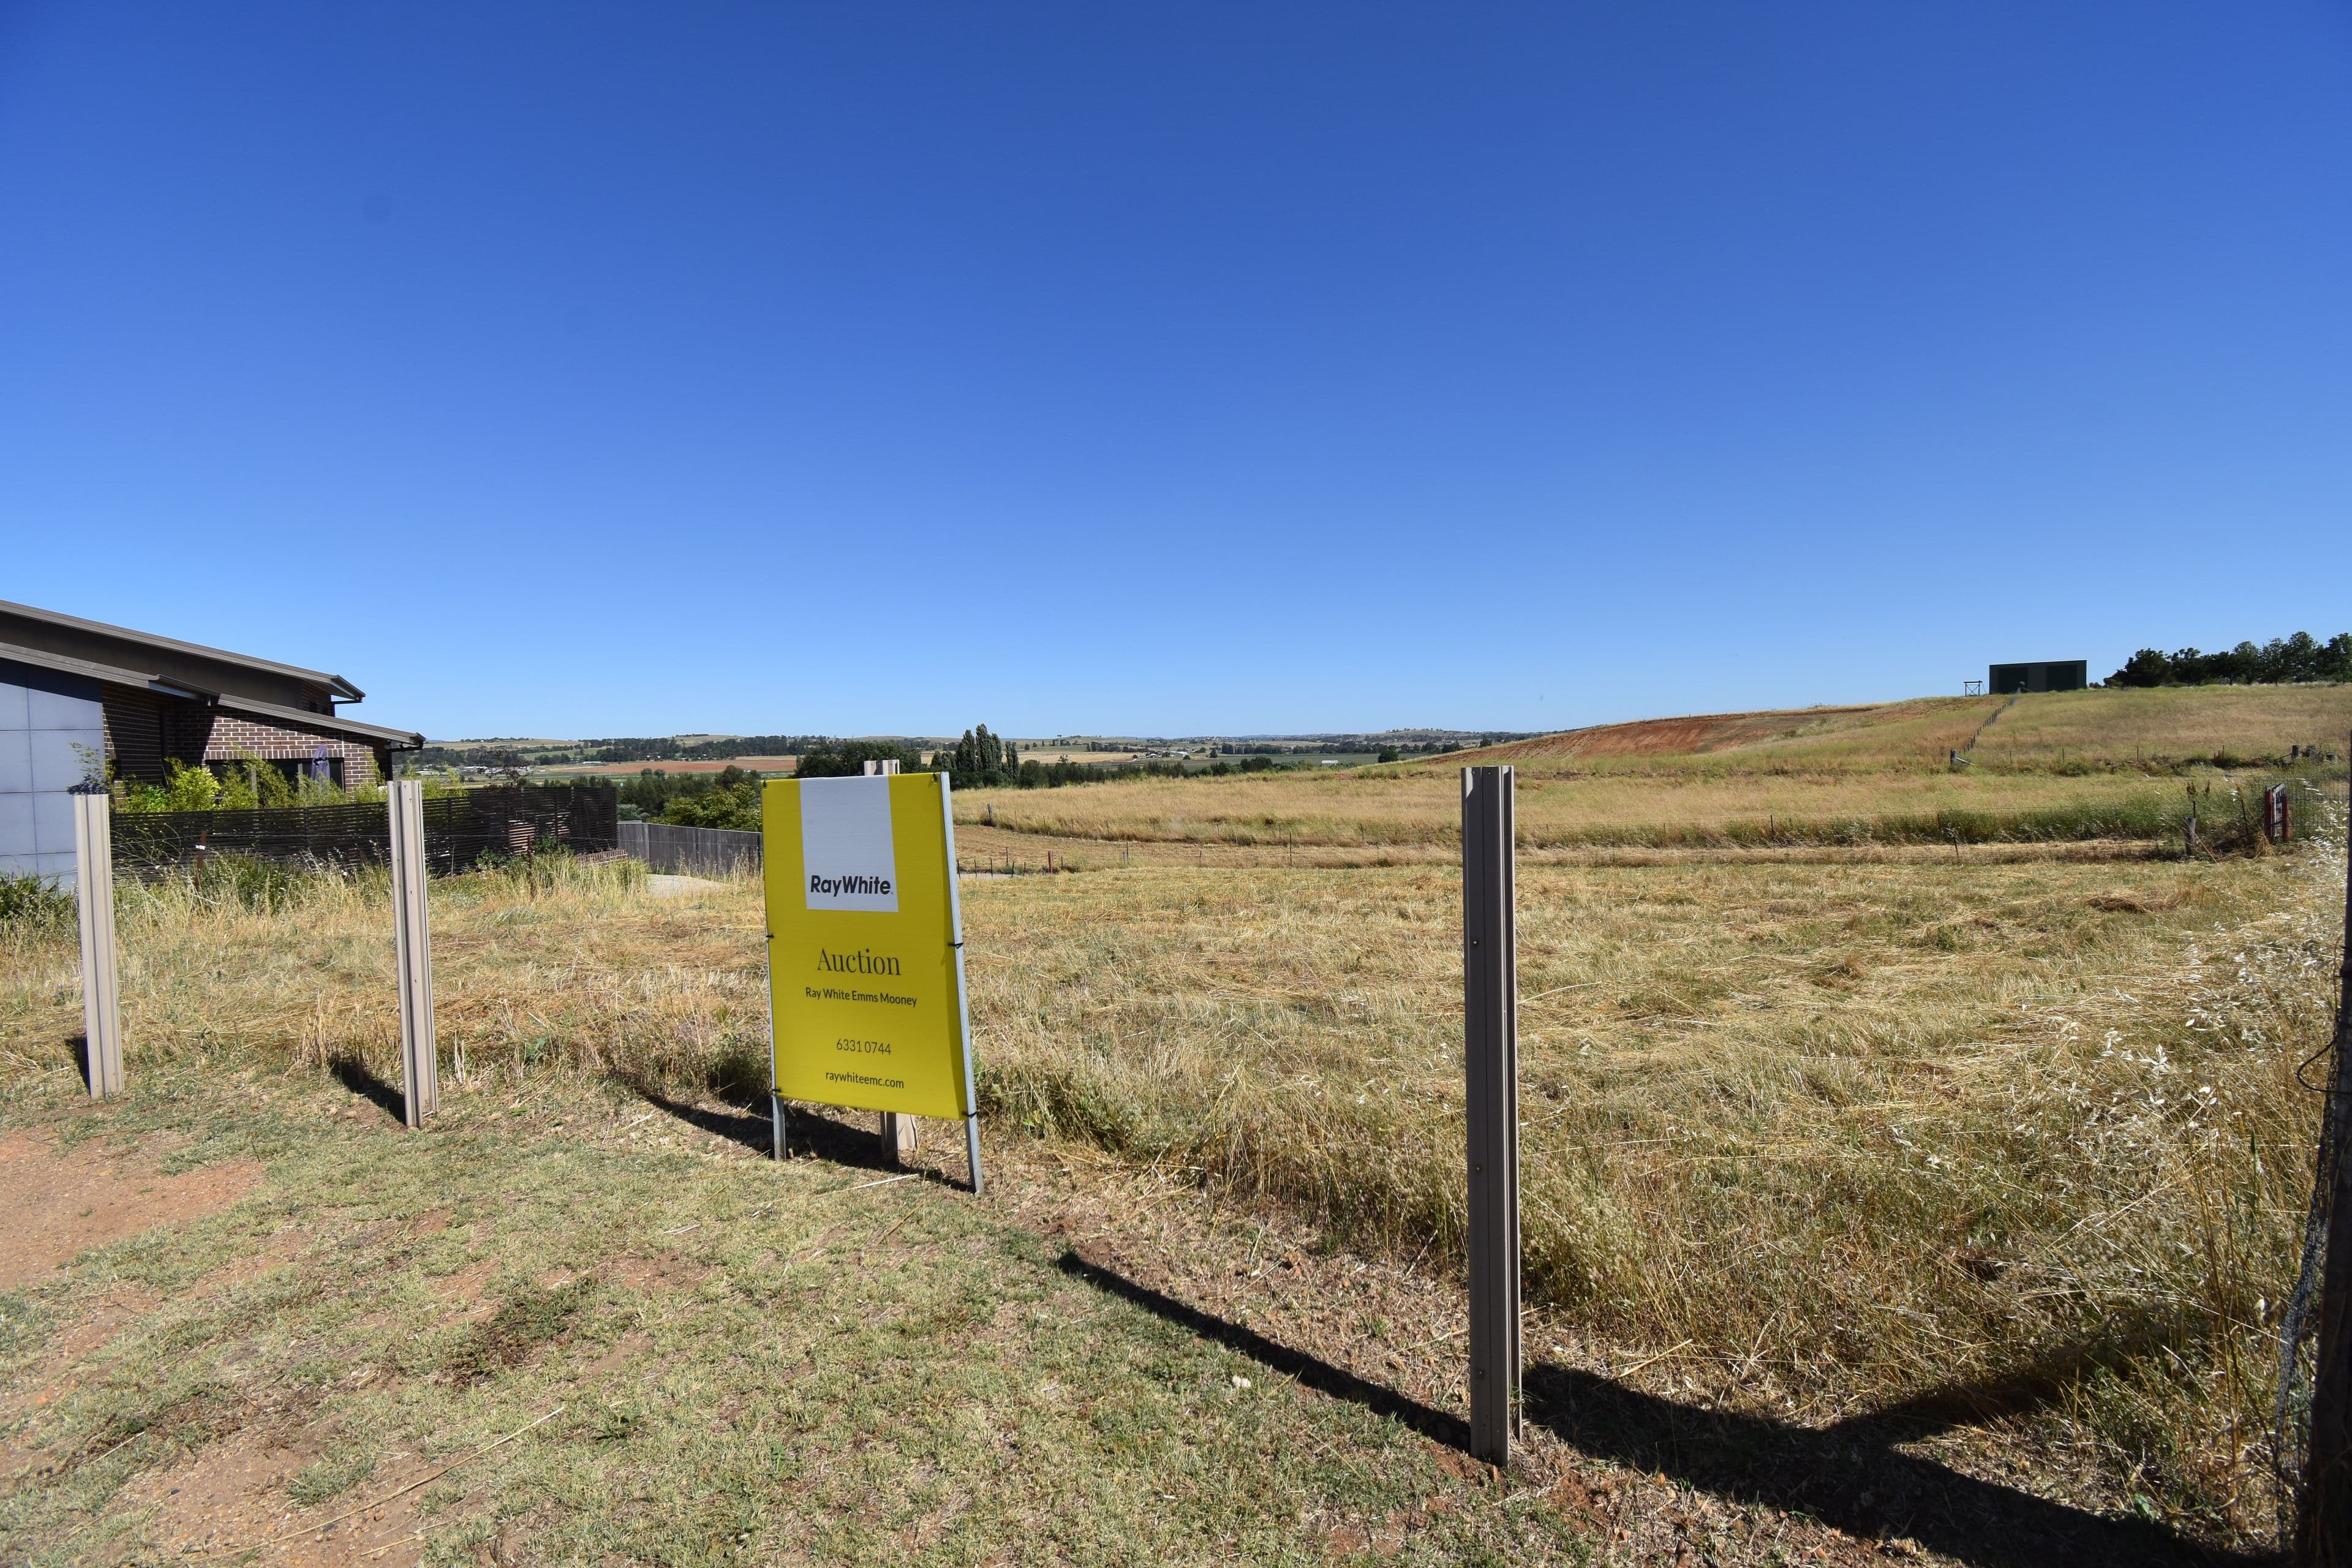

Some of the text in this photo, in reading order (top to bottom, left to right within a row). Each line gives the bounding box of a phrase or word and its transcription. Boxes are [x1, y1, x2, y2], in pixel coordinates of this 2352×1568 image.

[810, 875, 891, 897] RayWhite
[817, 948, 902, 976] Auction
[805, 987, 917, 1008] Ray White Emms Mooney
[837, 1039, 891, 1055] 6331 0744
[826, 1071, 904, 1088] raywhiteemc.com
